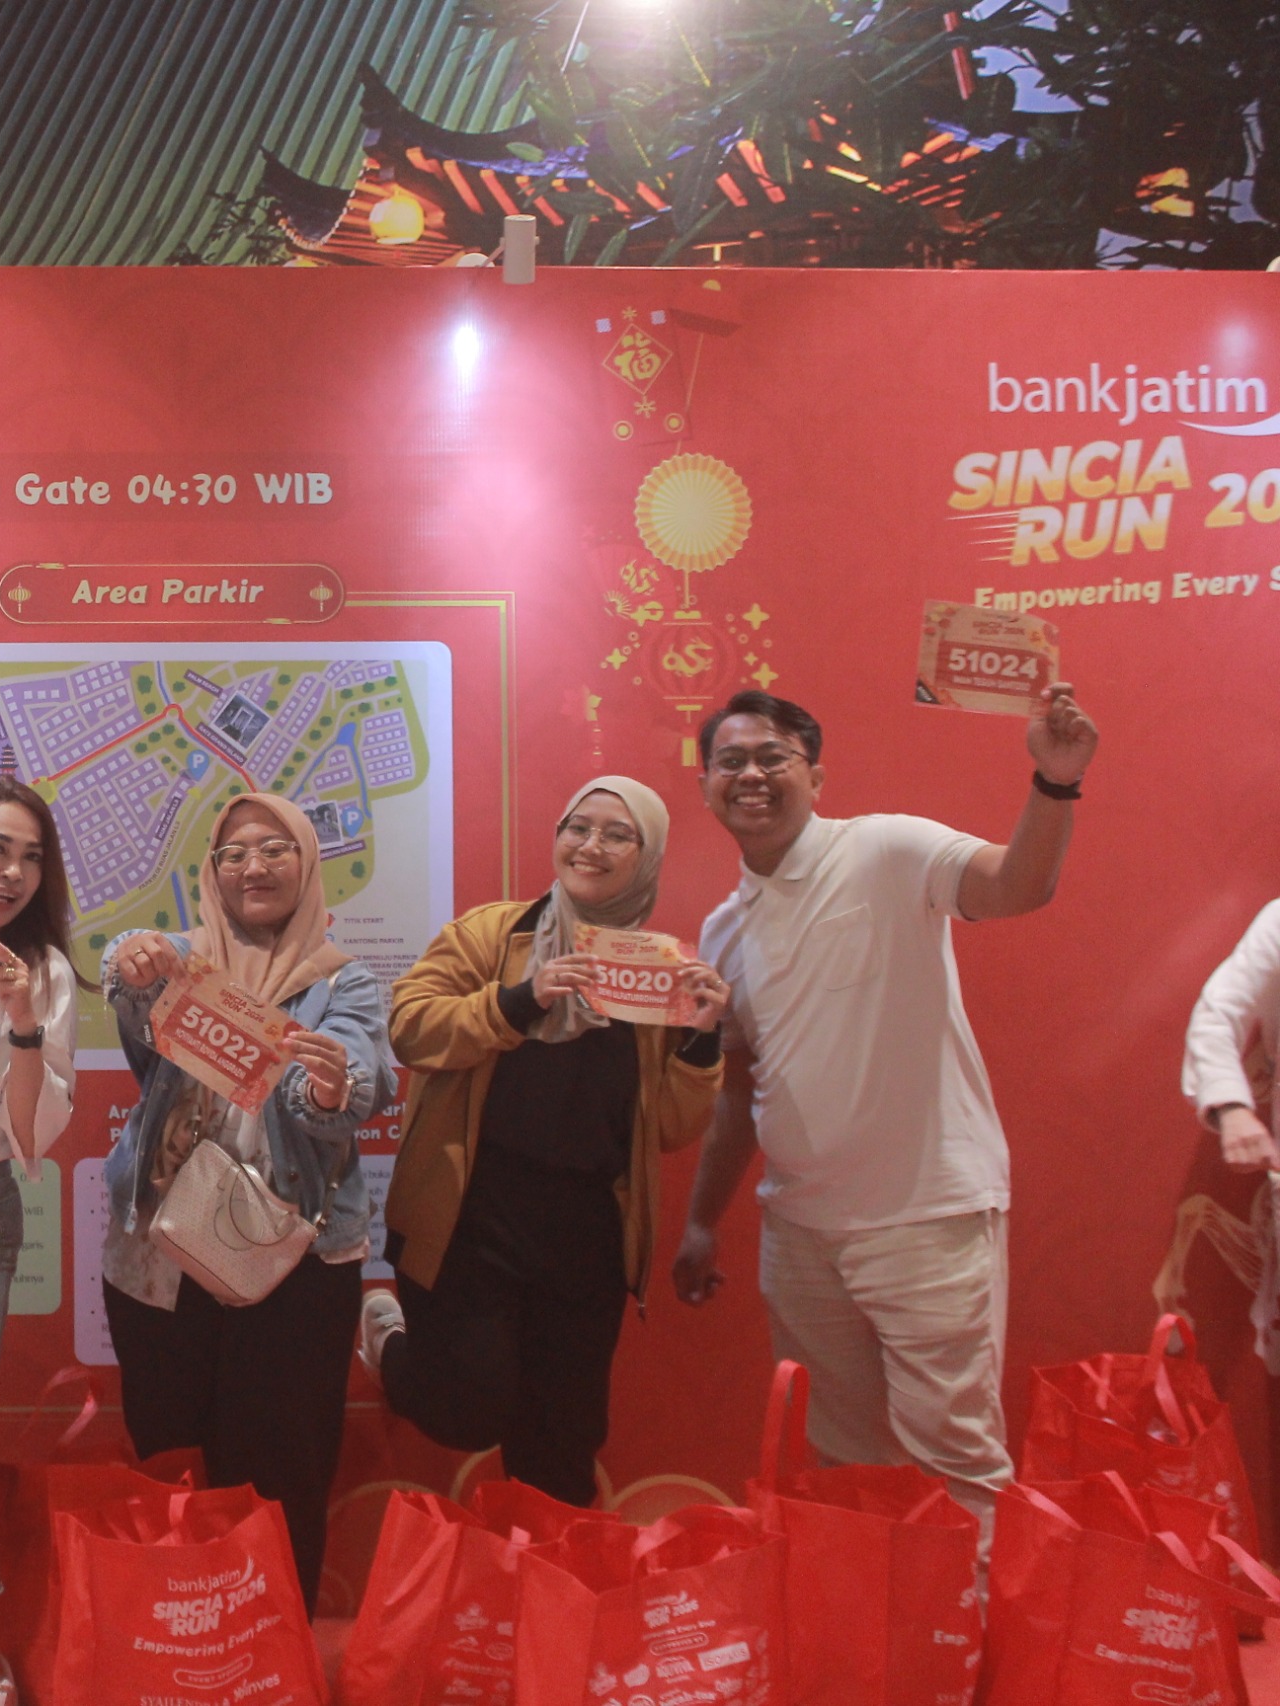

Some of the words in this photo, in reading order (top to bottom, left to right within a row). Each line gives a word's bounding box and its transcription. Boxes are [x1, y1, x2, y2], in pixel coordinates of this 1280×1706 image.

[614, 332, 660, 382] 福
[988, 362, 1268, 426] bankjatim
[15, 472, 111, 506] Gate
[127, 472, 237, 506] 04:30
[253, 472, 333, 505] WIB
[948, 435, 1192, 511] SINCIA
[1009, 493, 1173, 567] RUN
[72, 578, 148, 605] Area
[161, 578, 266, 605] Parkir
[974, 577, 1162, 613] Empowering
[1172, 571, 1260, 599] Every
[948, 648, 1038, 679] 51024
[595, 964, 673, 992] 51020
[181, 1005, 260, 1070] 51022
[153, 1594, 224, 1620] SINCIA
[227, 1573, 267, 1615] 2026
[167, 1569, 241, 1594] bankjatim
[170, 1611, 221, 1637] RUN
[132, 1637, 225, 1658] Empowering
